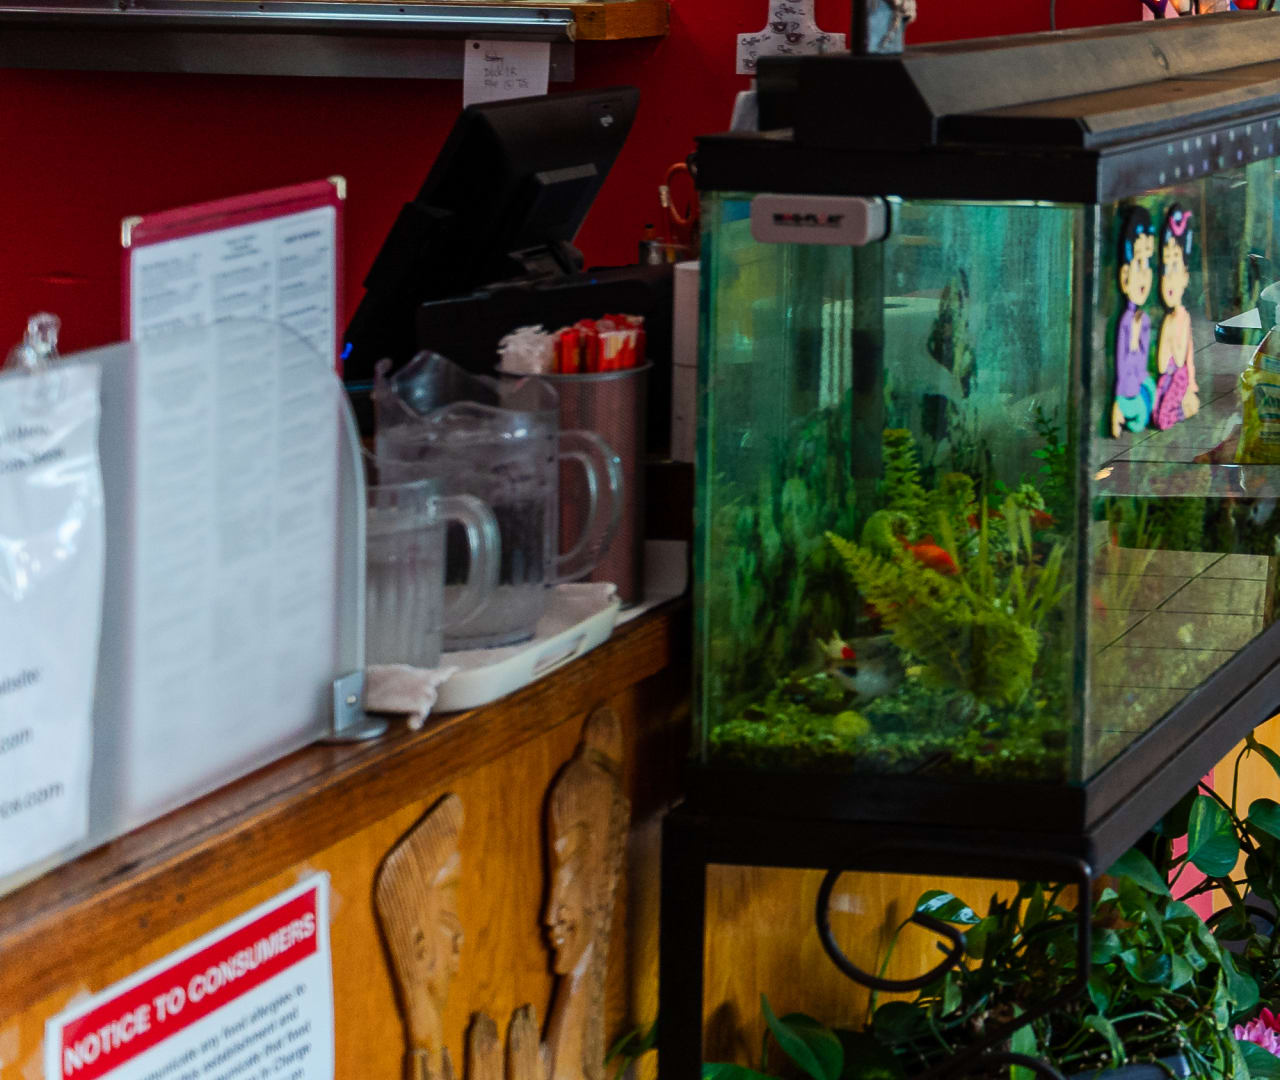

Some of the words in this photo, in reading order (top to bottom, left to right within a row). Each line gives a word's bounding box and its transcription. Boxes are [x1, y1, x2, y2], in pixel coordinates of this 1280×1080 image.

[63, 1003, 152, 1077] NOTICE
[153, 985, 186, 1022] TO
[187, 912, 316, 1004] CONSUMERS
